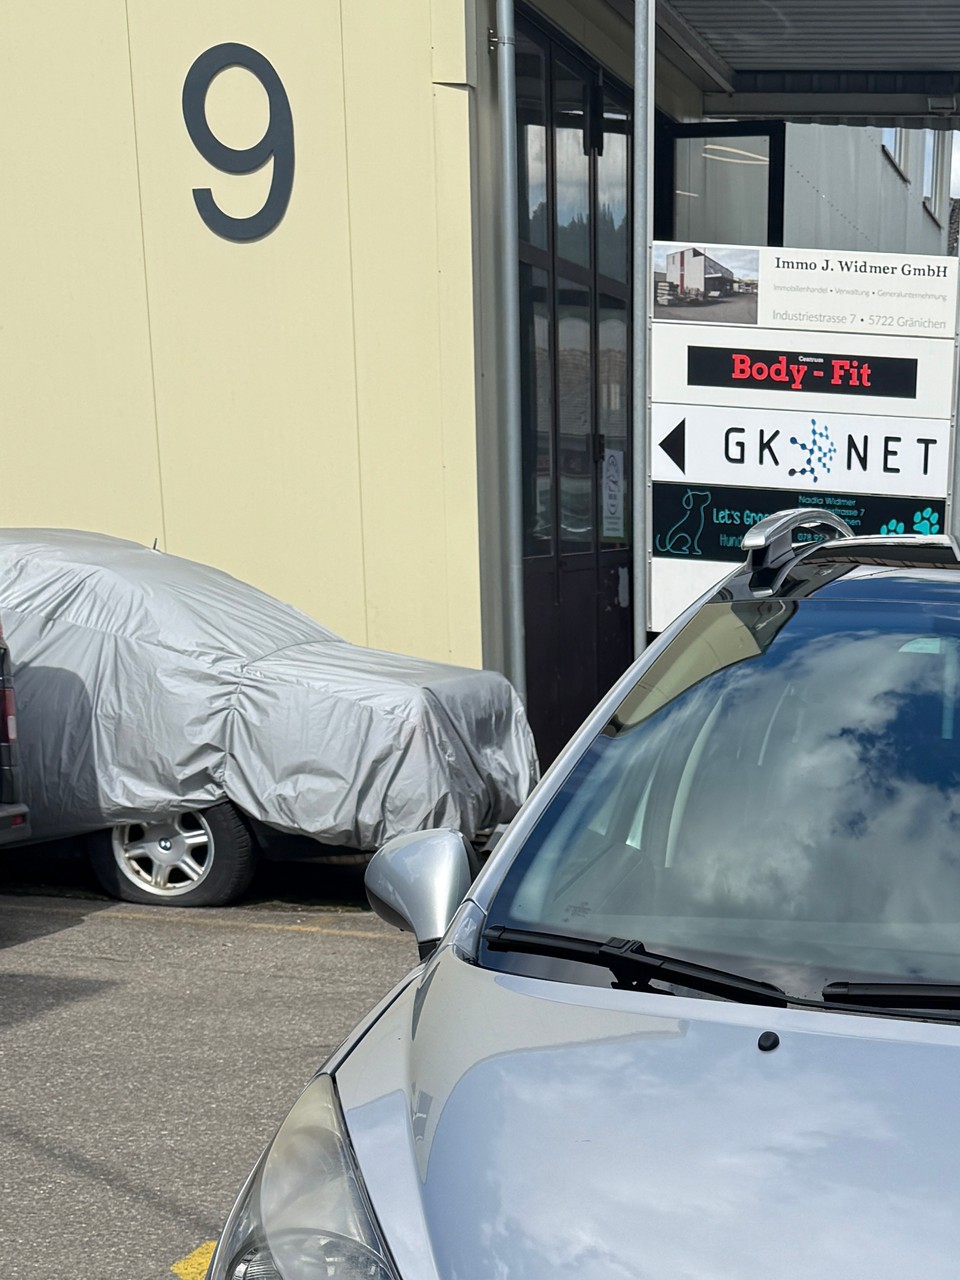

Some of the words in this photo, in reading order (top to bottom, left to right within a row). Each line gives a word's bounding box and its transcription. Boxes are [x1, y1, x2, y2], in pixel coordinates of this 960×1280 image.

[182, 42, 295, 243] 9
[774, 256, 817, 271] Immo
[821, 259, 834, 272] J.
[838, 260, 898, 275] Widmer
[901, 263, 948, 278] GmbH
[835, 288, 870, 297] Verwaltung
[772, 310, 847, 324] Industriestrasse
[850, 314, 856, 324] 7
[868, 315, 894, 327] 5722
[897, 316, 946, 330] Gränichen
[847, 433, 938, 475] NET
[799, 496, 823, 505] Nadia
[712, 508, 741, 524] Let's
